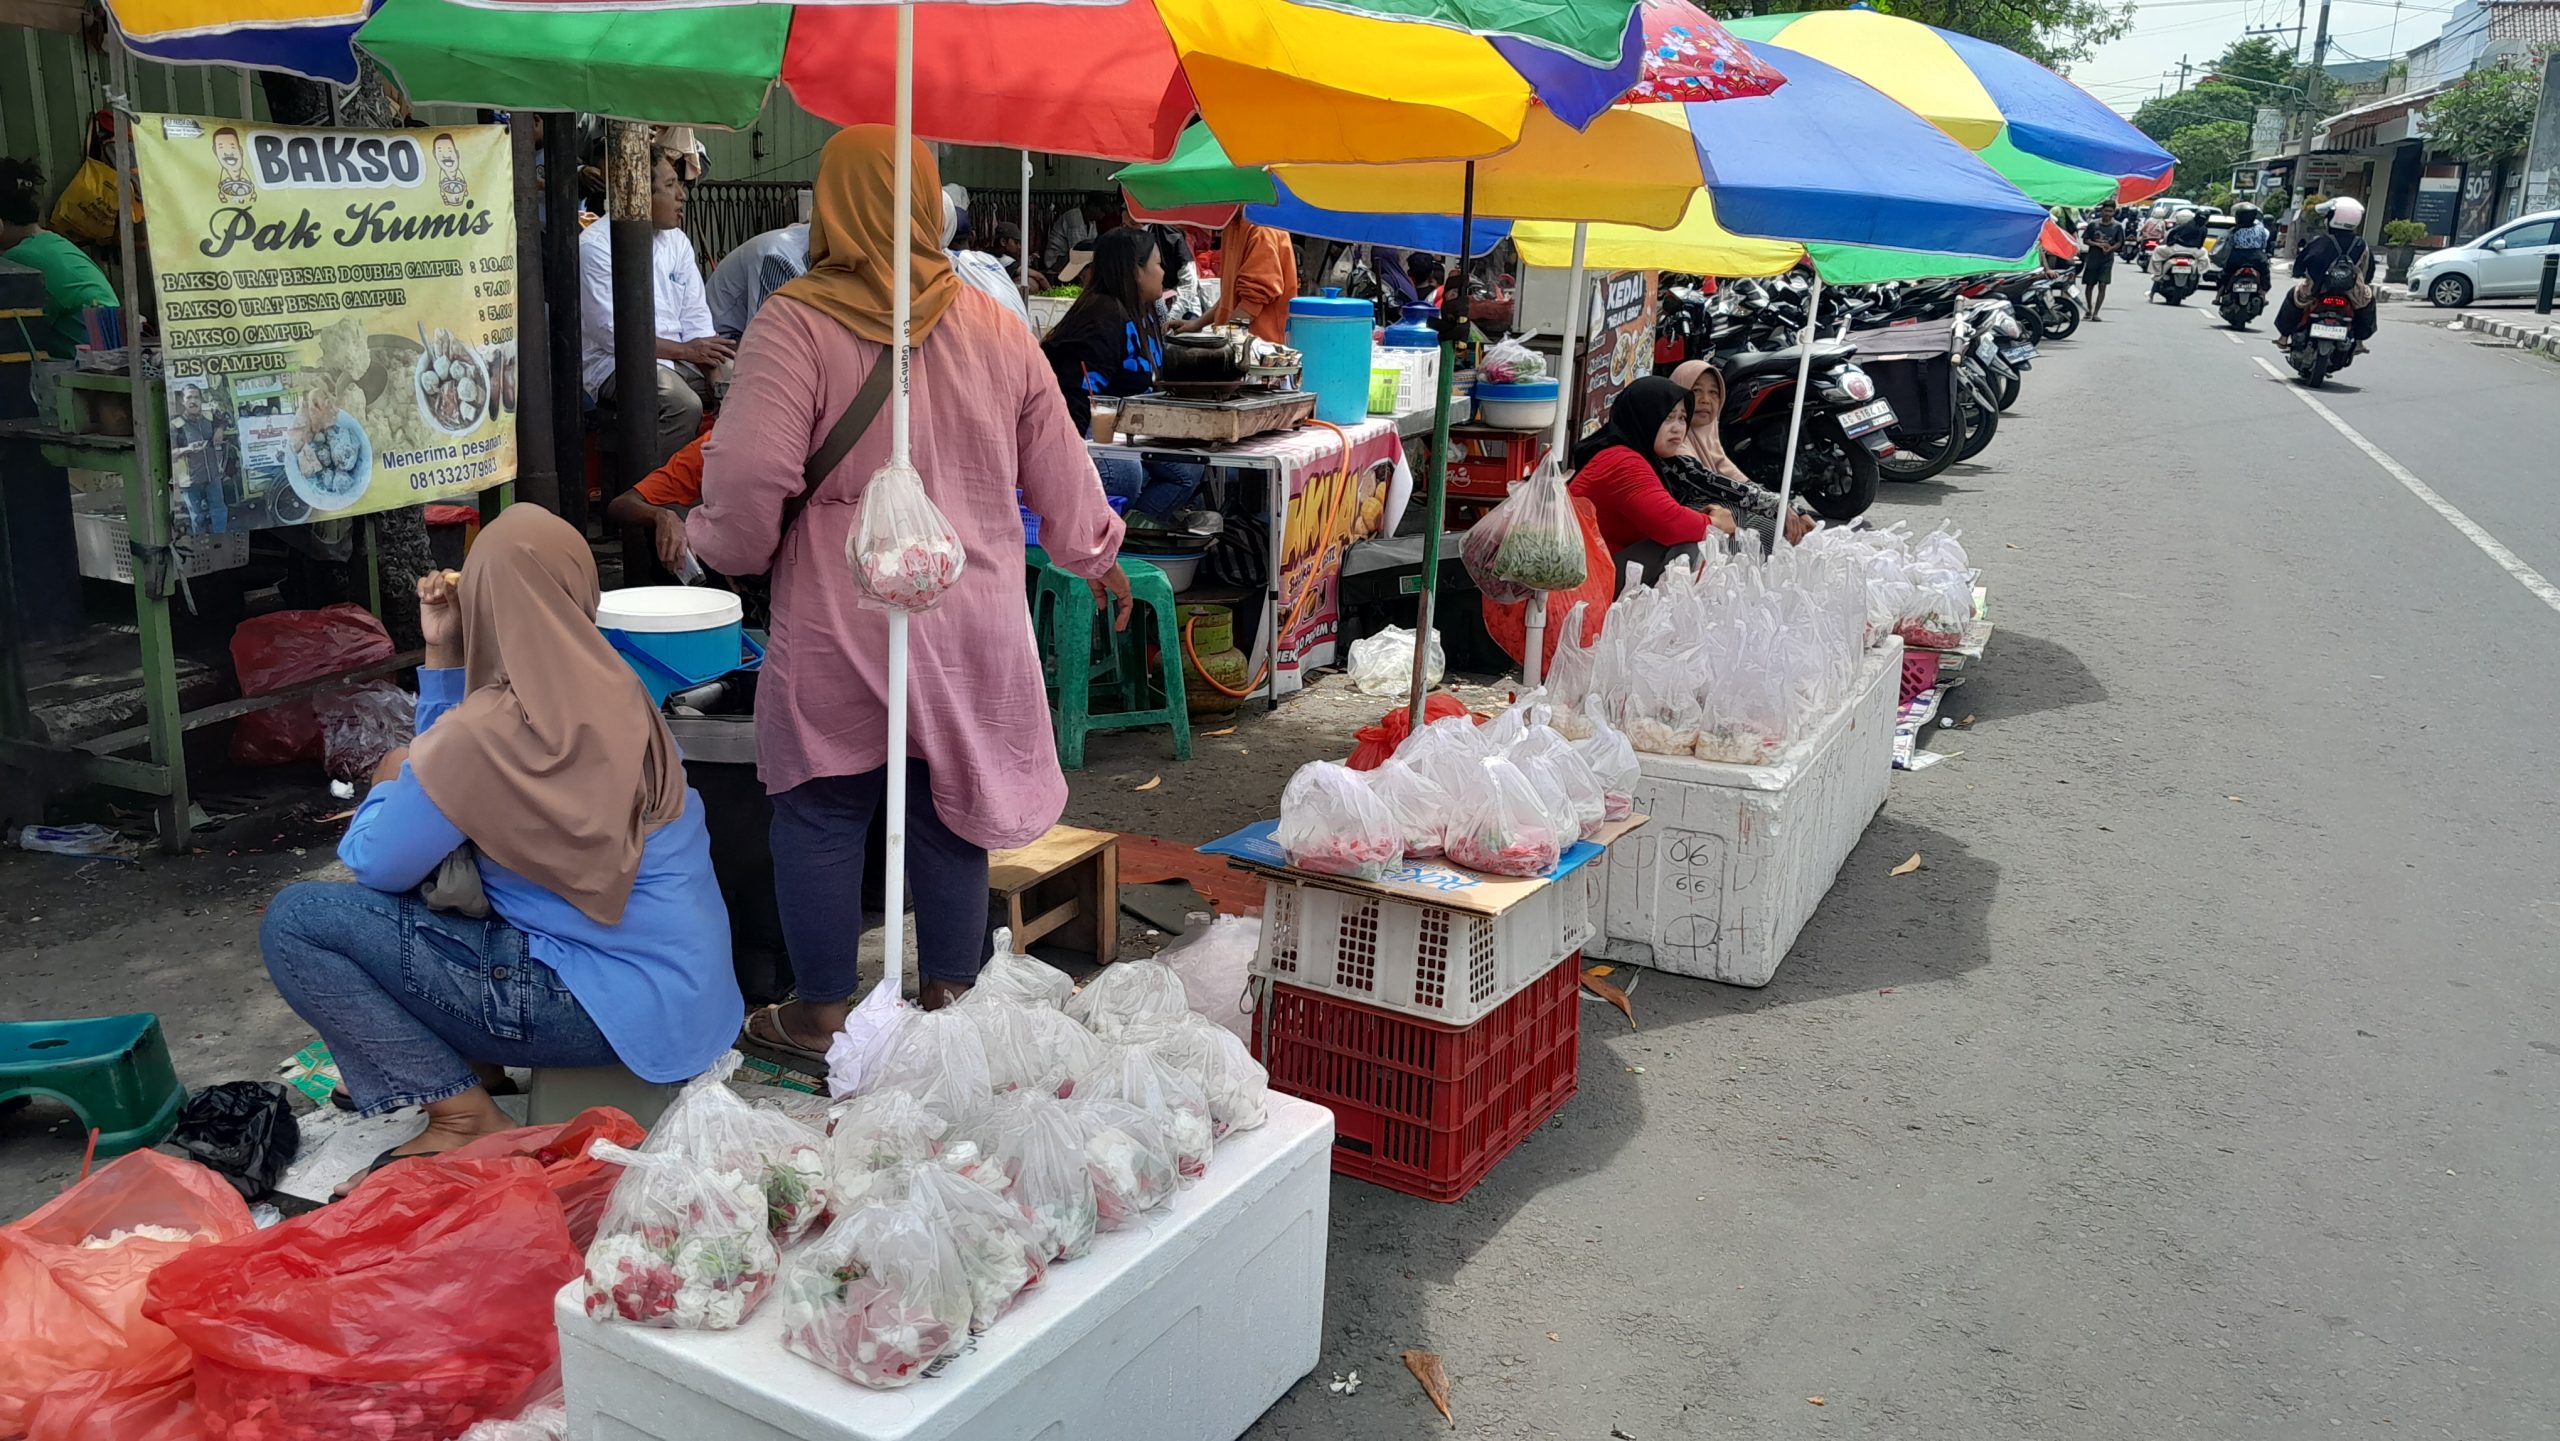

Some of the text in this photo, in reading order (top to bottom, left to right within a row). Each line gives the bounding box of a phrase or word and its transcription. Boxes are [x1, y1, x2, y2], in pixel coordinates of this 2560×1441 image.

[254, 135, 420, 184] BAKSO
[200, 199, 493, 257] Pak Kumis
[162, 271, 232, 292] BAKSO
[234, 270, 278, 288] URAT
[280, 267, 336, 285] BESAR
[338, 263, 403, 283] DOUBLE
[404, 260, 463, 278] CAMPUR
[1607, 272, 1643, 310] KEDAI
[167, 300, 237, 321] BAKSO
[239, 297, 284, 317] URAT
[286, 293, 340, 313] BESAR
[341, 289, 406, 308] CAMPUR
[170, 327, 240, 349] BAKSO
[243, 322, 313, 344] CAMPUR
[174, 359, 203, 377] ES
[206, 352, 286, 374] CAMPUR
[382, 445, 457, 469] Menerima
[461, 434, 501, 460] pesanan
[1670, 838, 1709, 866] 06
